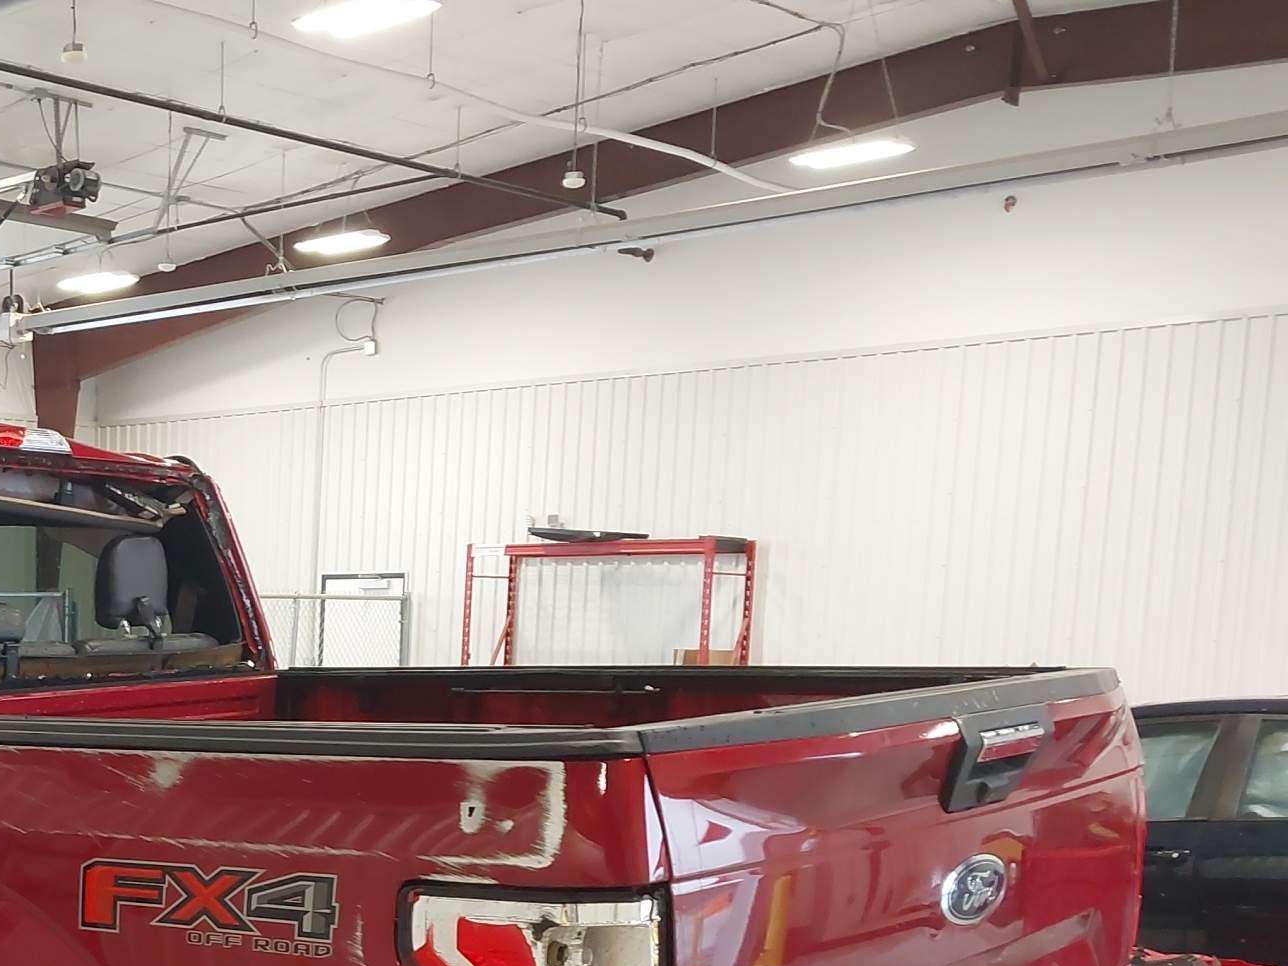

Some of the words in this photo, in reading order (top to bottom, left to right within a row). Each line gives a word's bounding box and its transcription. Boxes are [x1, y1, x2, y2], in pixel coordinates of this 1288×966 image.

[79, 857, 339, 943] FX4
[186, 930, 242, 948] OFF
[252, 937, 333, 958] ROAD
